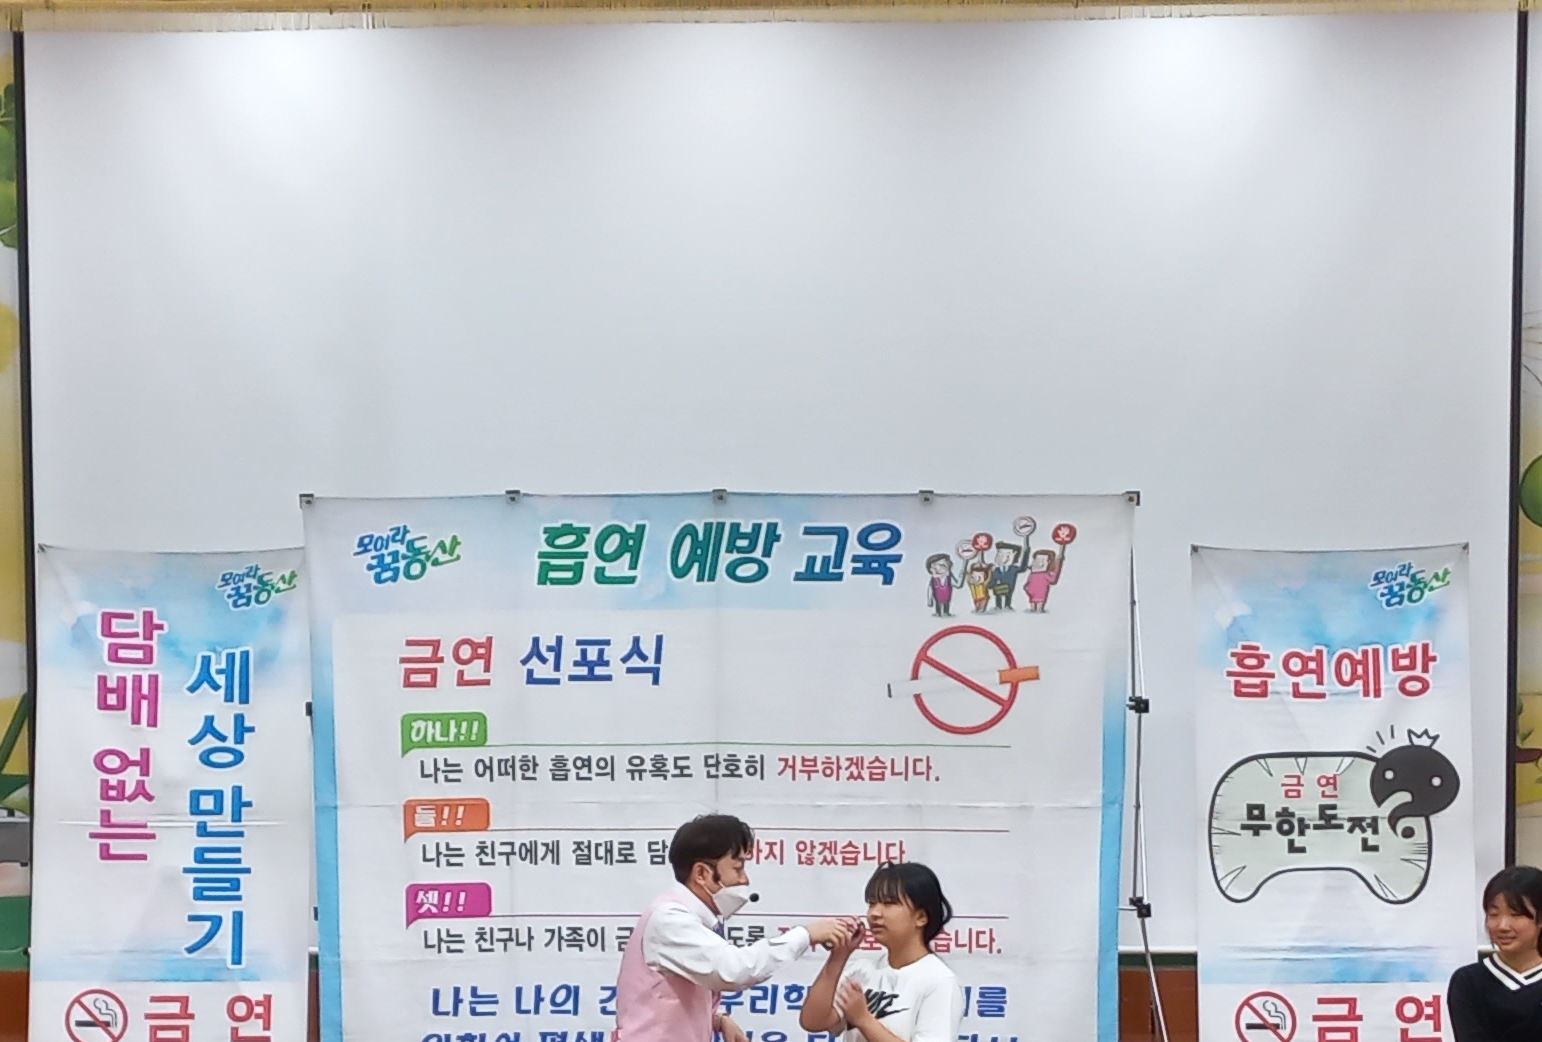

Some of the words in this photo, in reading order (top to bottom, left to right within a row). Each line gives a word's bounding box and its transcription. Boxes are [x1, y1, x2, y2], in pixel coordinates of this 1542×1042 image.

[537, 523, 646, 585] 흡연
[671, 522, 781, 583] 예방
[793, 522, 903, 585] 교육
[97, 610, 165, 728] 담배
[399, 636, 493, 688] 금연
[520, 634, 664, 686] 선포식
[1226, 643, 1437, 699] 흡연예방
[186, 650, 255, 769] 세상
[410, 719, 479, 742] 하나!!
[420, 757, 463, 783] 나는
[474, 755, 539, 782] 어떠한
[549, 755, 615, 781] 흡연의
[626, 754, 694, 781] 유혹도
[703, 753, 765, 781] 단호히
[777, 755, 940, 782] 거부하겠습니다.
[89, 748, 156, 861] 없는
[1240, 804, 1379, 854] 무한도전
[182, 785, 253, 966] 만들기
[422, 841, 465, 867] 나는
[475, 840, 560, 866] 친구에게
[572, 840, 637, 866] 절대로
[416, 890, 466, 914] 셋!!
[423, 927, 465, 953] 나는
[475, 926, 534, 953] 친구나
[544, 926, 605, 952] 가족이
[432, 985, 499, 1017] 나는
[515, 983, 580, 1016] 나의
